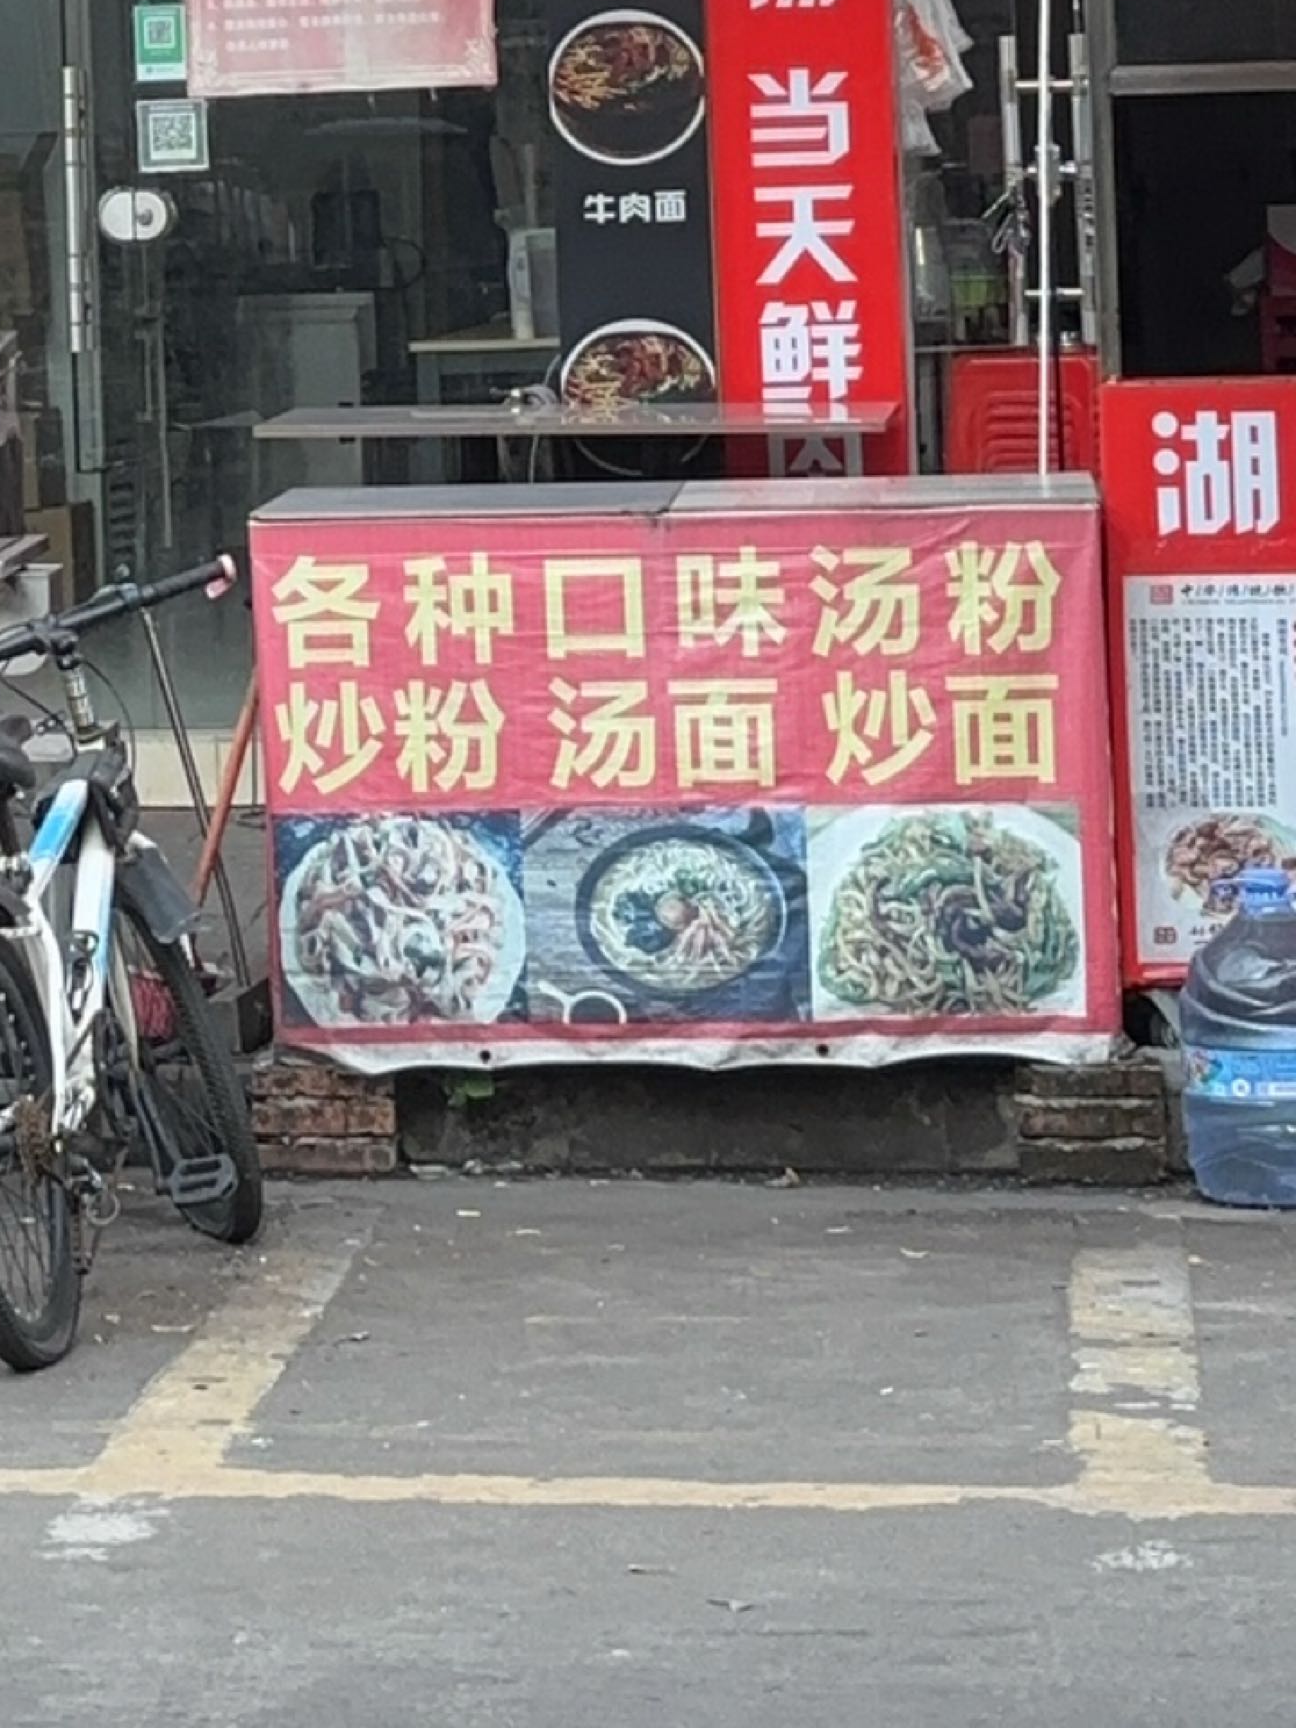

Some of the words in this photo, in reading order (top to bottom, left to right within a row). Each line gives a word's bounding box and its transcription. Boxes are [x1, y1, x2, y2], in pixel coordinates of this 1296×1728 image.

[582, 189, 687, 225] 牛肉面
[1151, 409, 1281, 537] 湖
[271, 538, 1062, 670] 各种口味汤粉
[274, 676, 506, 797] 炒粉
[547, 676, 780, 791] 汤面
[824, 669, 1059, 787] 炒面
